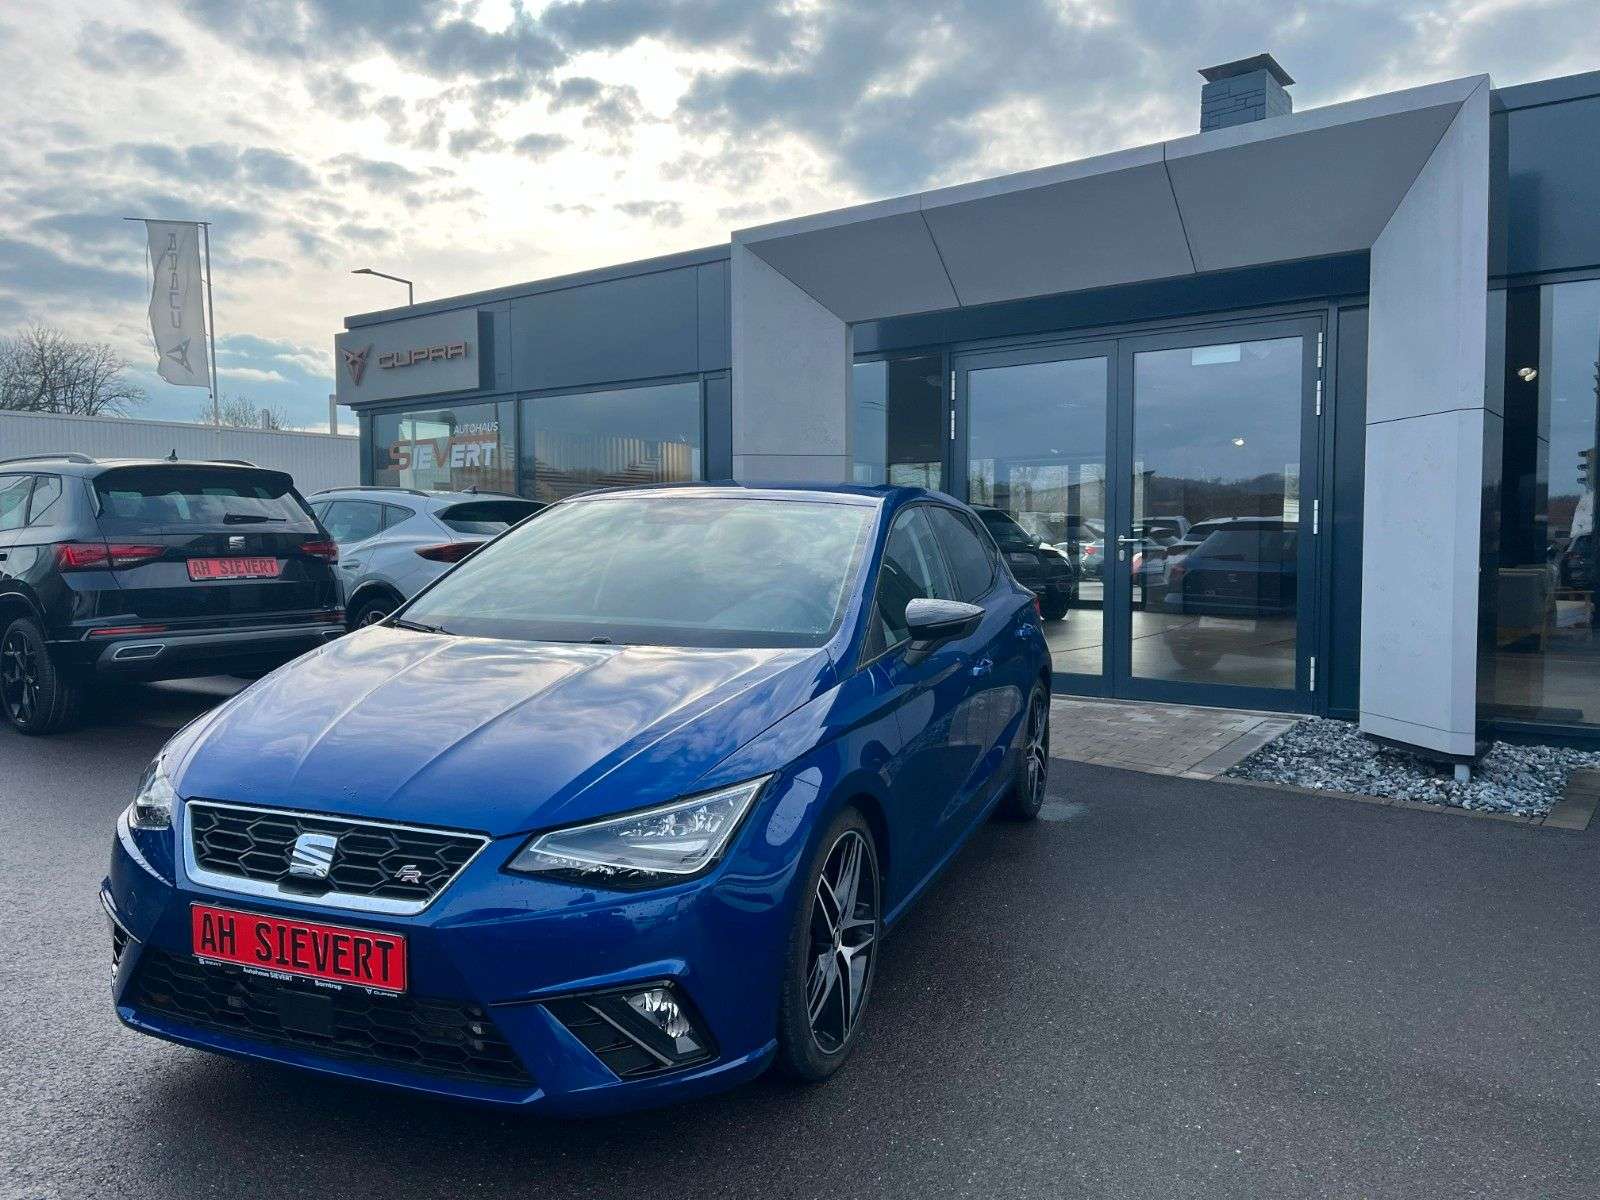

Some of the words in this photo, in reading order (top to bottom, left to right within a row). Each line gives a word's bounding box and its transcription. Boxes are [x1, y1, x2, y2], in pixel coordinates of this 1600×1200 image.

[378, 343, 467, 369] CUPRA
[454, 421, 499, 434] AUTOHAUS
[389, 438, 498, 471] SIEVERT
[193, 560, 209, 575] AH
[221, 559, 276, 574] SIEVERT
[394, 864, 422, 884] FR
[200, 911, 236, 955] AH
[255, 922, 394, 982] SIEVERT
